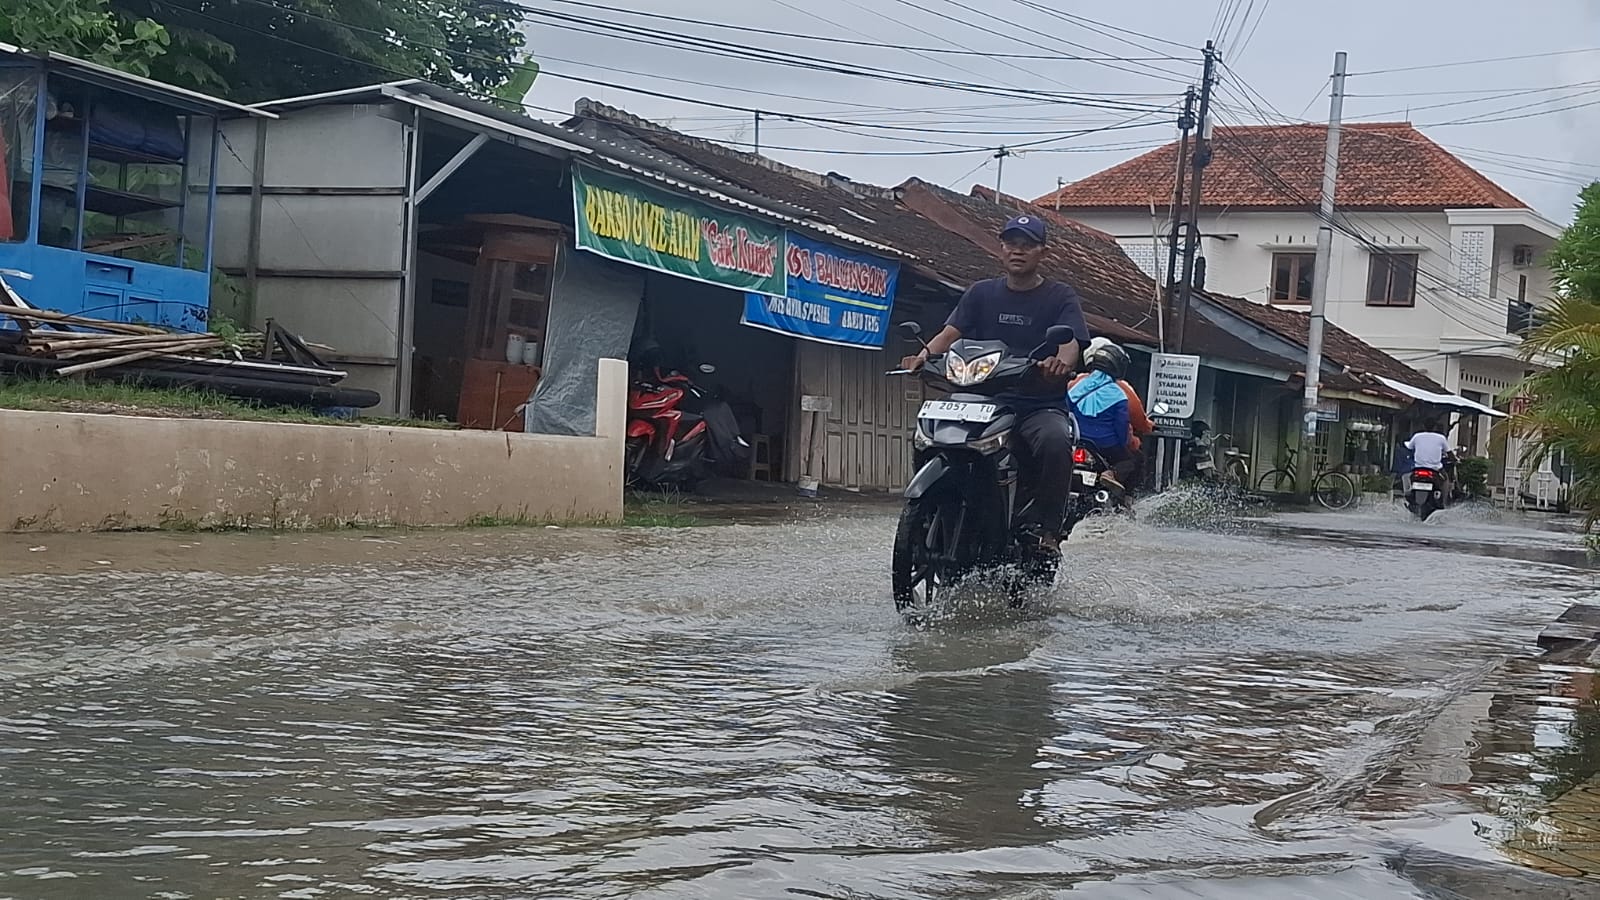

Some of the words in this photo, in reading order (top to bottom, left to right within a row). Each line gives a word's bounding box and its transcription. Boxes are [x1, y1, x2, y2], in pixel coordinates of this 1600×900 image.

[585, 184, 631, 243] BAKSO
[632, 197, 643, 246] &
[643, 201, 667, 252] MIE
[814, 252, 888, 298] BALUNGAN
[802, 301, 830, 325] SPESIAL
[1155, 373, 1192, 381] PENGAWAS
[1156, 389, 1187, 397] LULUSAN
[938, 402, 968, 411] 2057
[979, 405, 994, 413] TU
[1154, 418, 1184, 426] KENDAL
